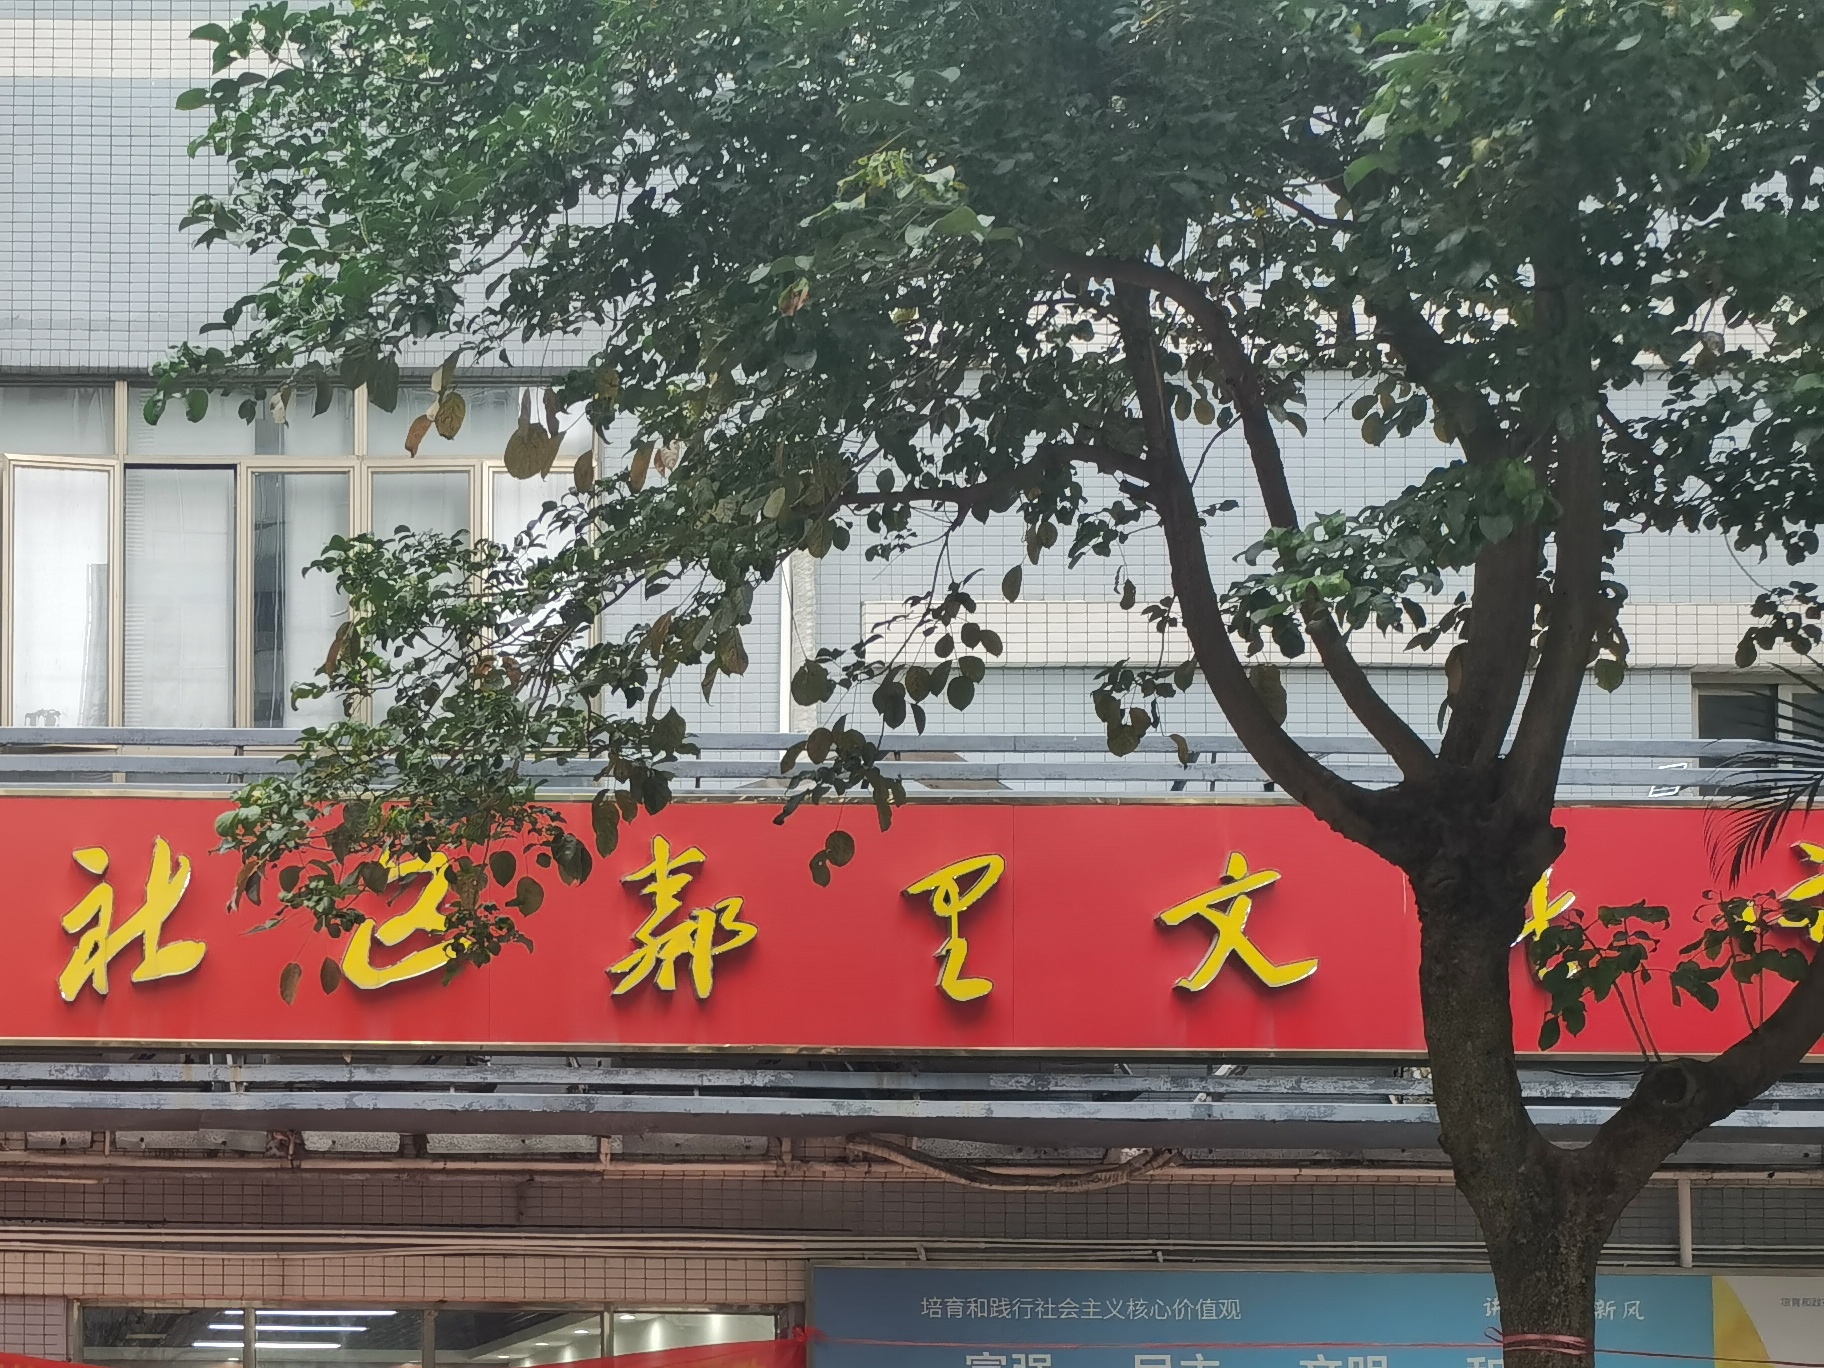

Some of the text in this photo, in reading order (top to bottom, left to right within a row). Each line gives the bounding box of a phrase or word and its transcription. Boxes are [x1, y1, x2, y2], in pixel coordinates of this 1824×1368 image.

[920, 1297, 1242, 1321] 培育和践行社会主义核心价值观
